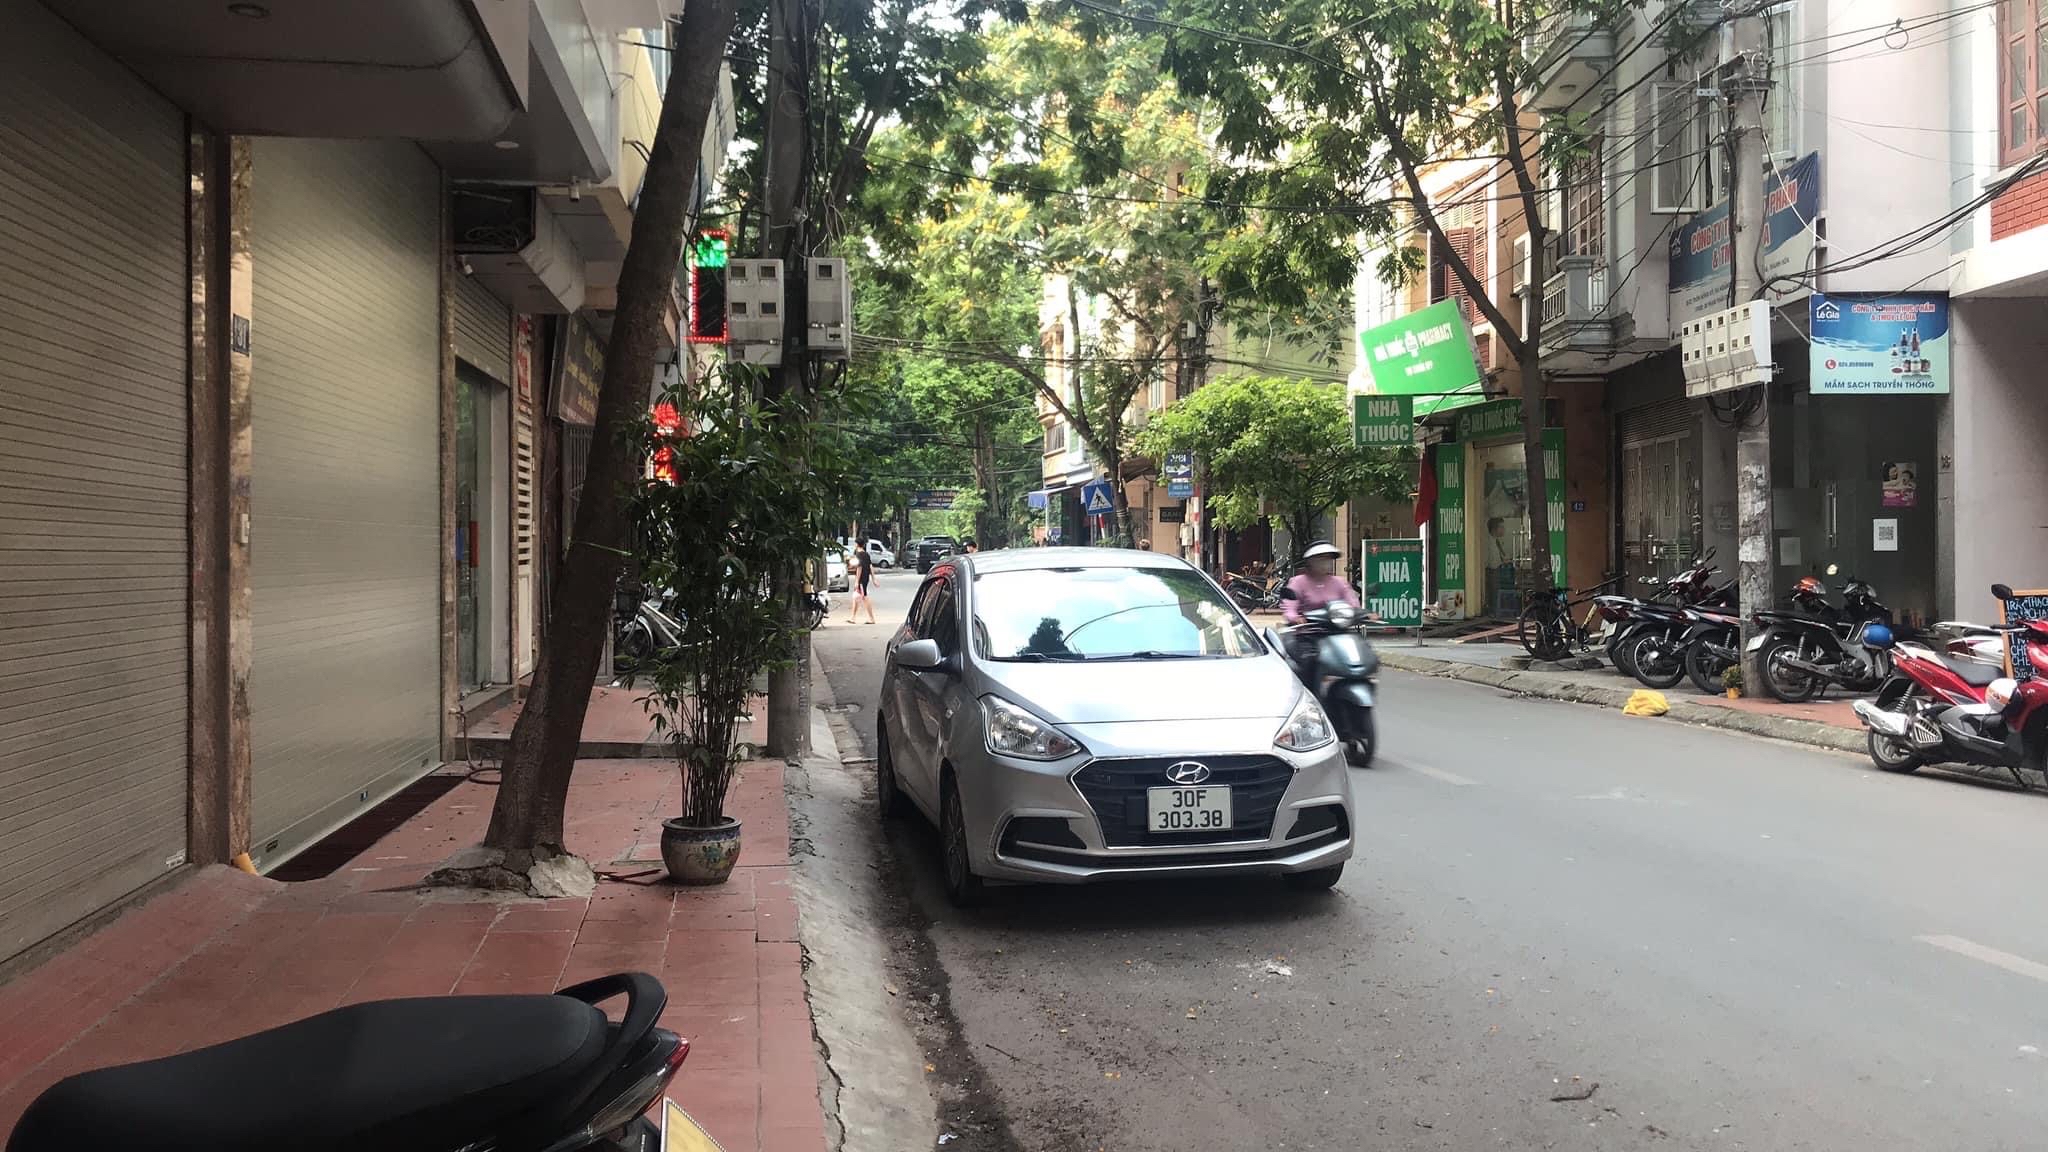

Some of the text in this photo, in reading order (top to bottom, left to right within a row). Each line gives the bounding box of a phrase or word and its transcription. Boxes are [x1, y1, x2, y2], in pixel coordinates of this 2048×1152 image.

[1769, 174, 1798, 216] PHẨM
[1691, 226, 1712, 254] CÔNG
[1816, 310, 1840, 319] Lê Gia
[1847, 381, 1871, 390] SẠCH
[1368, 396, 1400, 417] NHÀ
[1360, 418, 1409, 442] THUỐC
[1443, 456, 1459, 488] NHÀ
[1439, 499, 1463, 534] THUỐC
[1547, 491, 1564, 532] UỐC
[1378, 557, 1410, 583] NHÀ
[1445, 553, 1460, 580] GPP
[1370, 590, 1419, 619] THUỐC
[1172, 789, 1208, 808] 30F
[1158, 810, 1223, 829] 303.38
